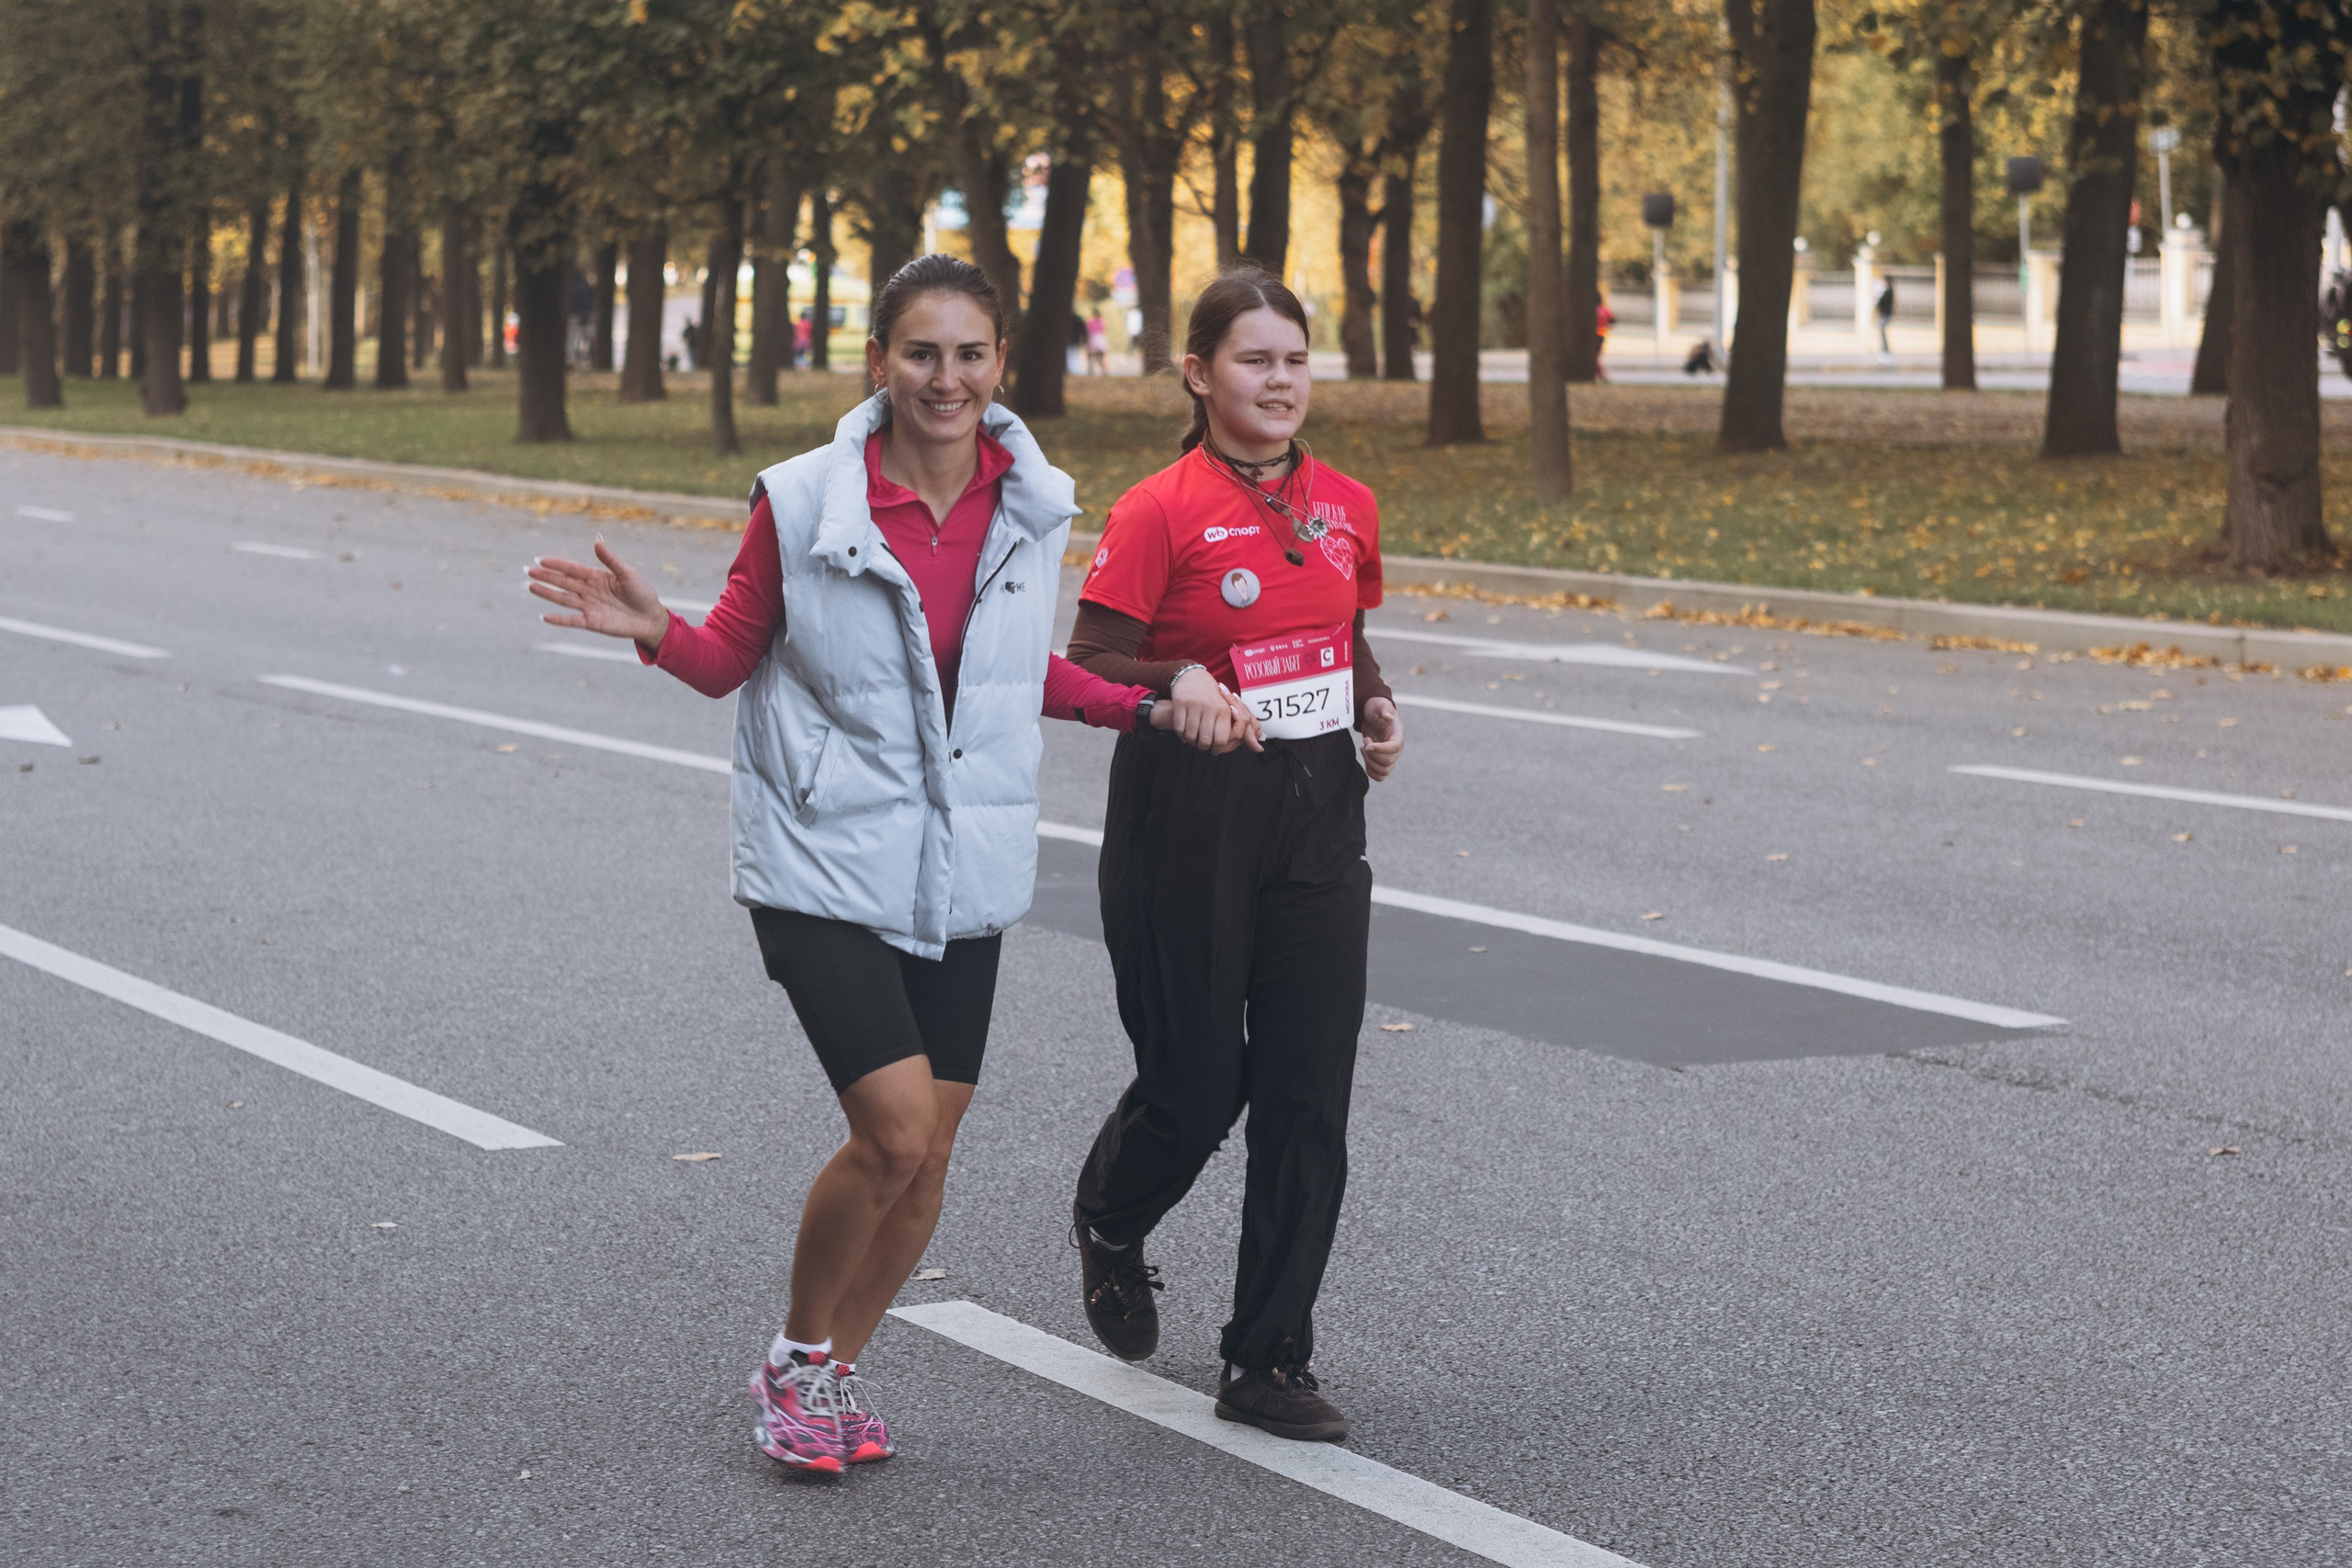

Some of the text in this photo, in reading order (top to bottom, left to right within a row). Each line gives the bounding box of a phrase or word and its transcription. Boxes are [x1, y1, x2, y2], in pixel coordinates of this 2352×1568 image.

[1228, 525, 1261, 537] спорт
[1244, 654, 1301, 681] РОЗОВЫЙ ЗАБЕГ
[1256, 687, 1330, 722] 31527
